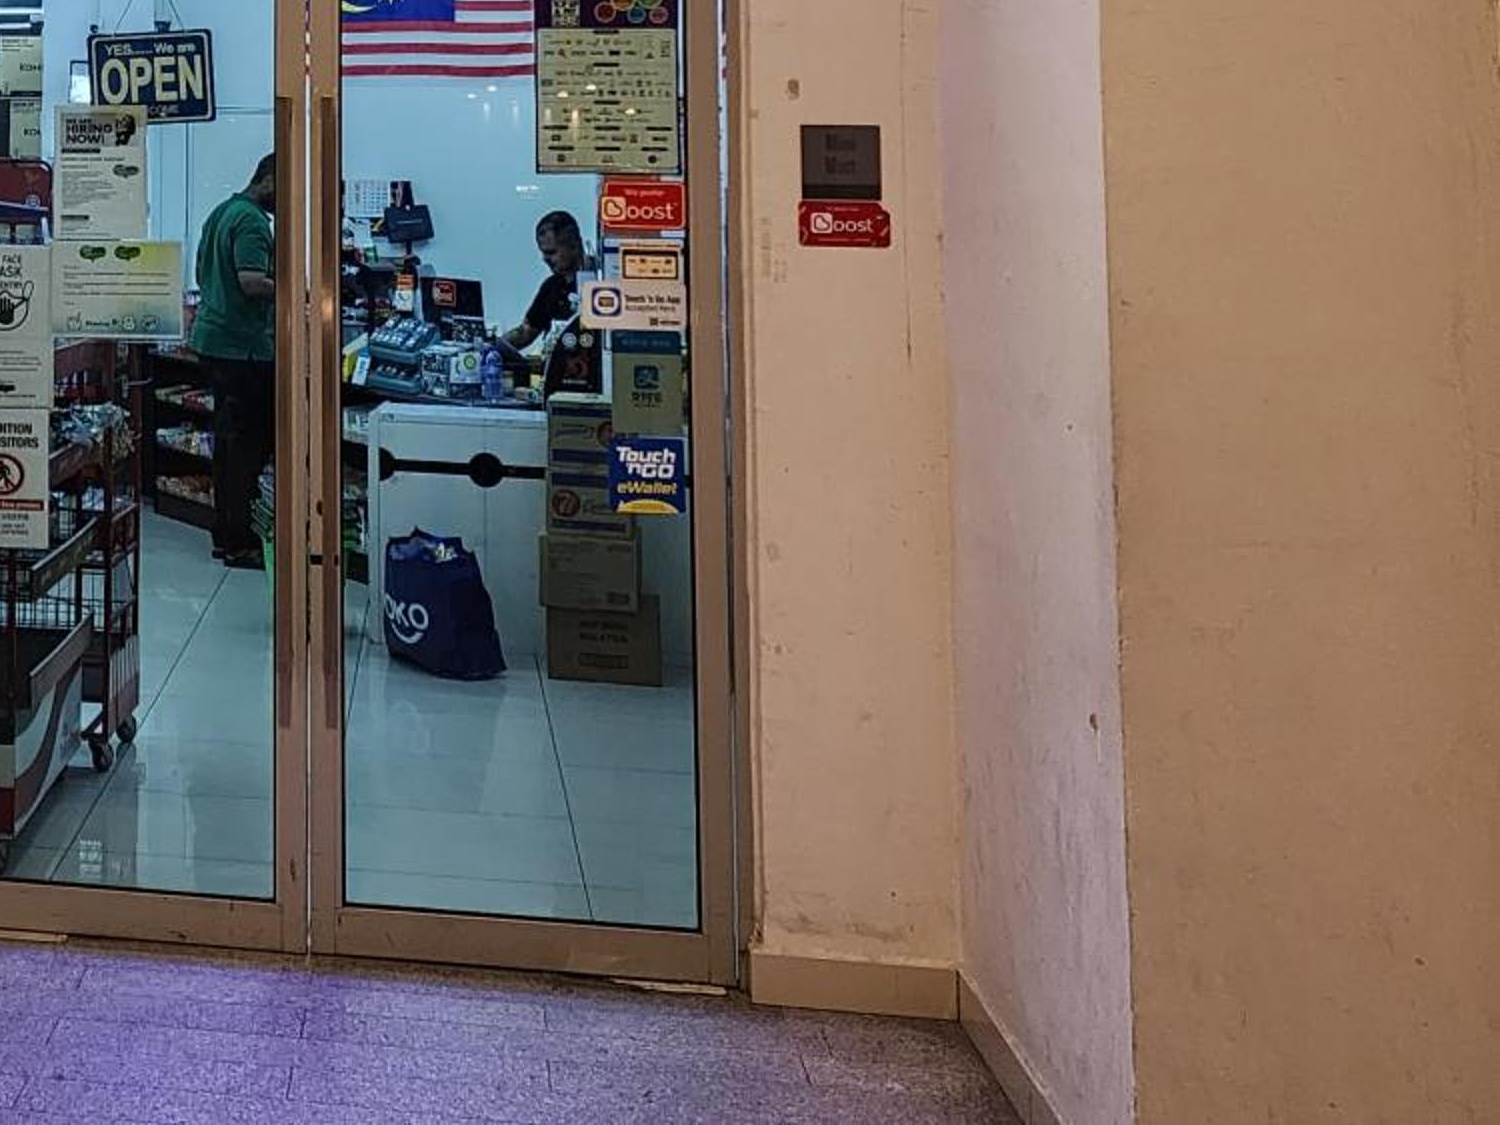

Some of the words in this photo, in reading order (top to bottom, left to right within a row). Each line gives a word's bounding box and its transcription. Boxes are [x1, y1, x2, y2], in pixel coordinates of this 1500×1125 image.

[154, 42, 174, 54] We
[177, 41, 196, 53] are
[101, 55, 204, 105] OPEN
[67, 123, 112, 133] HIRING
[67, 134, 104, 145] NOW!
[2, 255, 22, 264] FACE
[616, 446, 676, 463] Touch
[617, 481, 677, 495] eWallet
